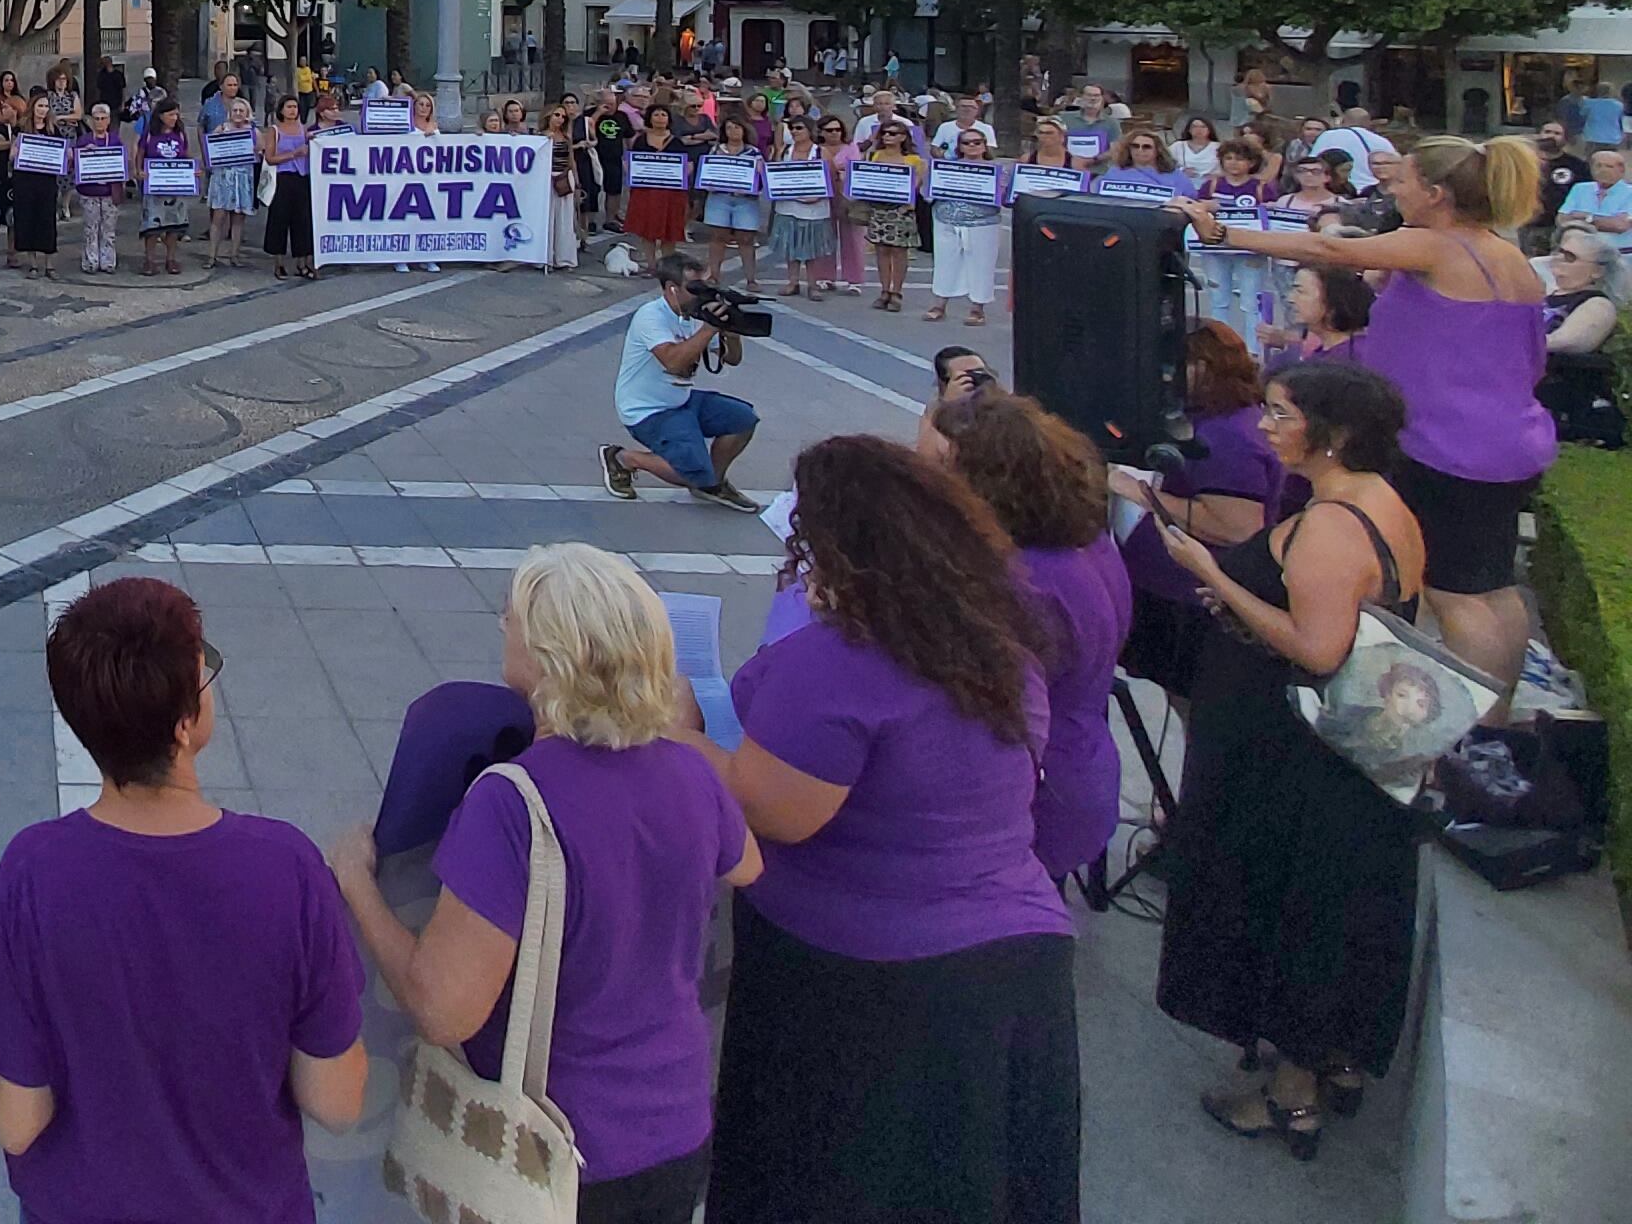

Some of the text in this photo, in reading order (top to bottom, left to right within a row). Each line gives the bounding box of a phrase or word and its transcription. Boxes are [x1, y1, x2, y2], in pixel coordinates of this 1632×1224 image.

[321, 144, 536, 175] EL MACHISMO
[327, 181, 521, 221] MATA
[456, 232, 487, 251] ROSAS
